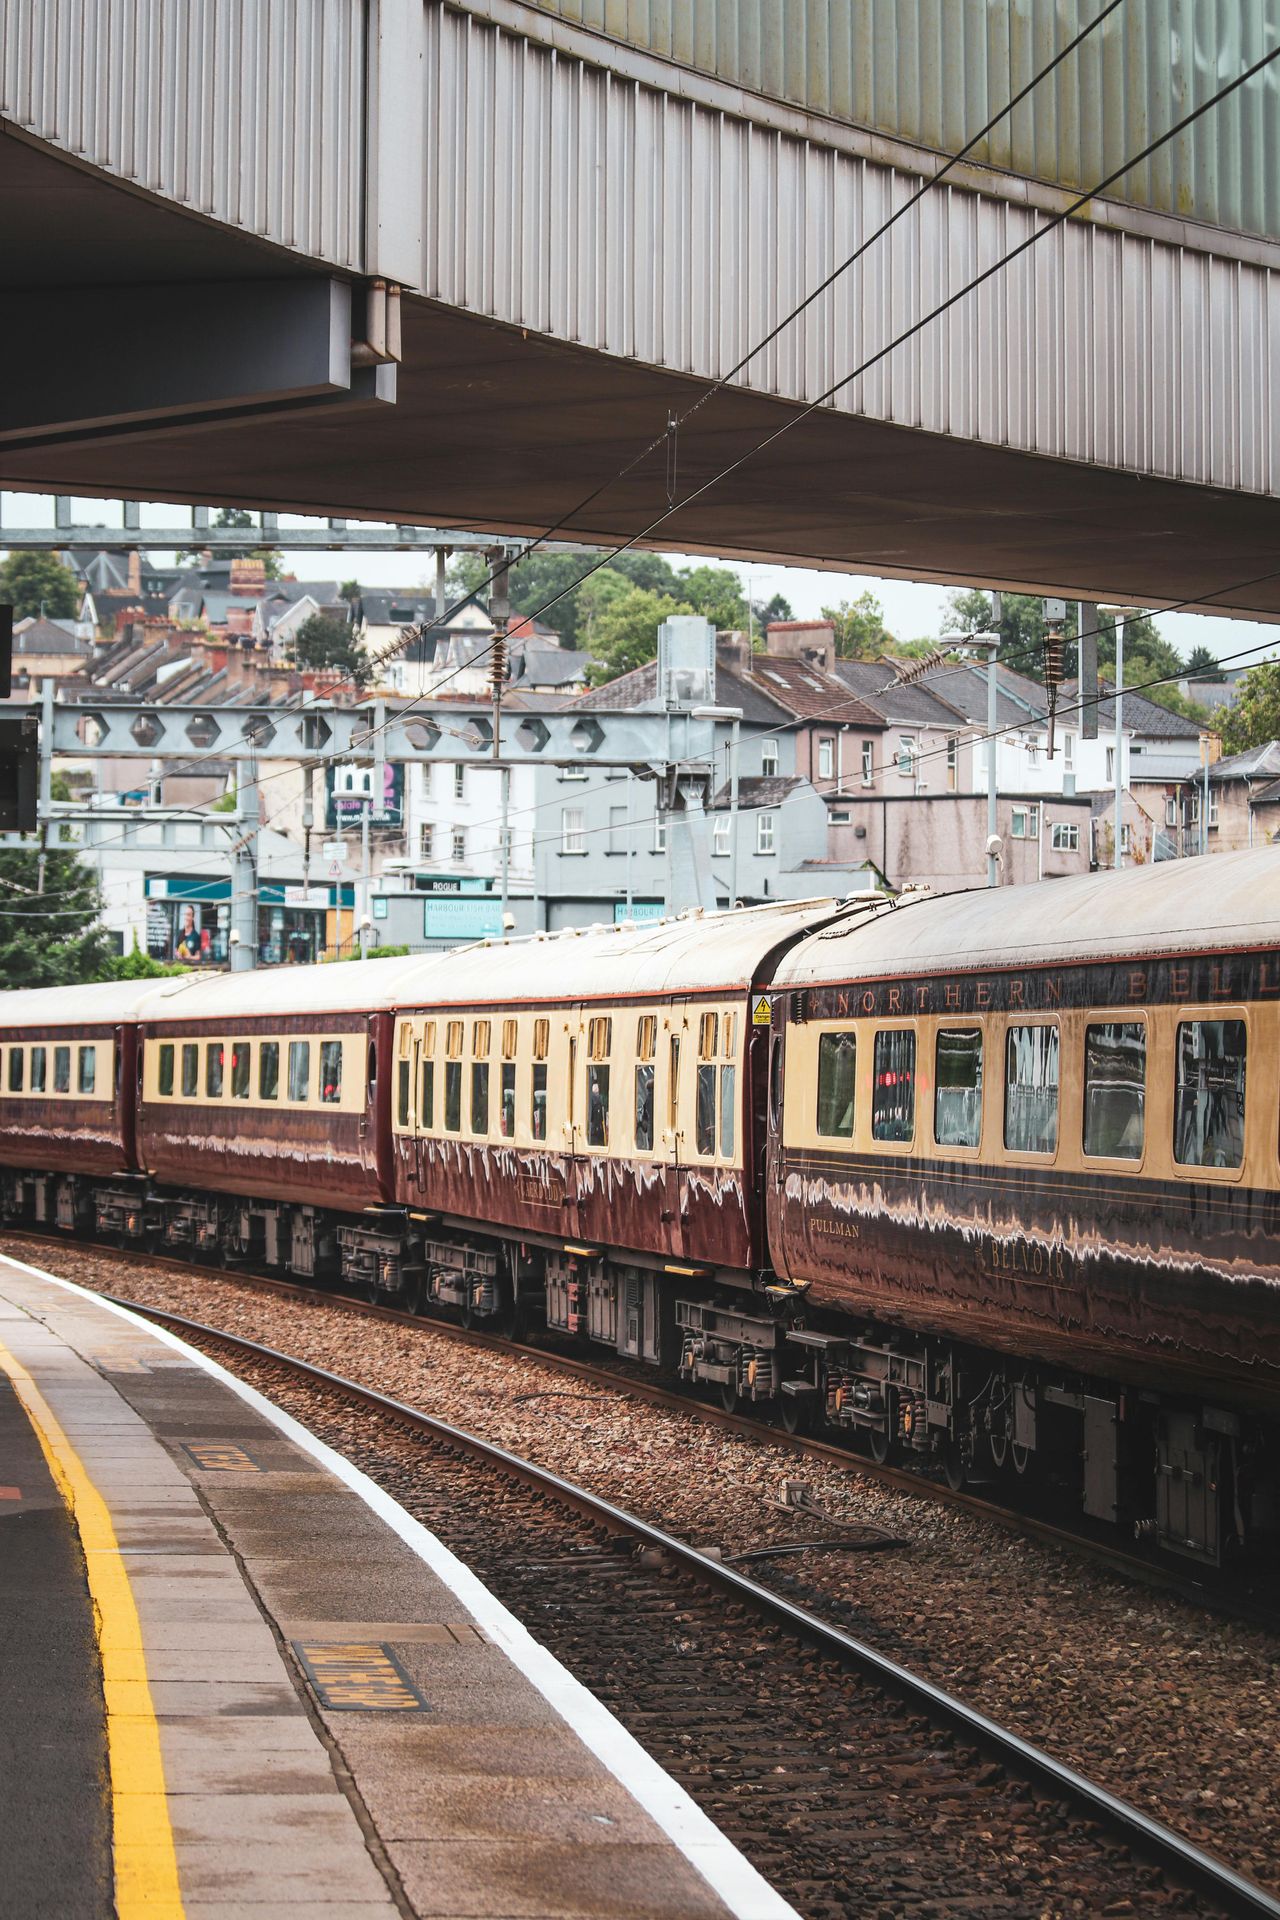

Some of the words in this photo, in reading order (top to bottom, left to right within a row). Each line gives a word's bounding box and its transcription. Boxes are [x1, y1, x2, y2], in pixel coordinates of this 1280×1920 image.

[432, 881, 459, 892] ROGUE
[837, 976, 1062, 1015] NORTHERN
[1129, 963, 1280, 998] BELL
[810, 1218, 860, 1238] PULLMAN
[314, 1667, 403, 1684] THE
[325, 1686, 420, 1708] GAP
